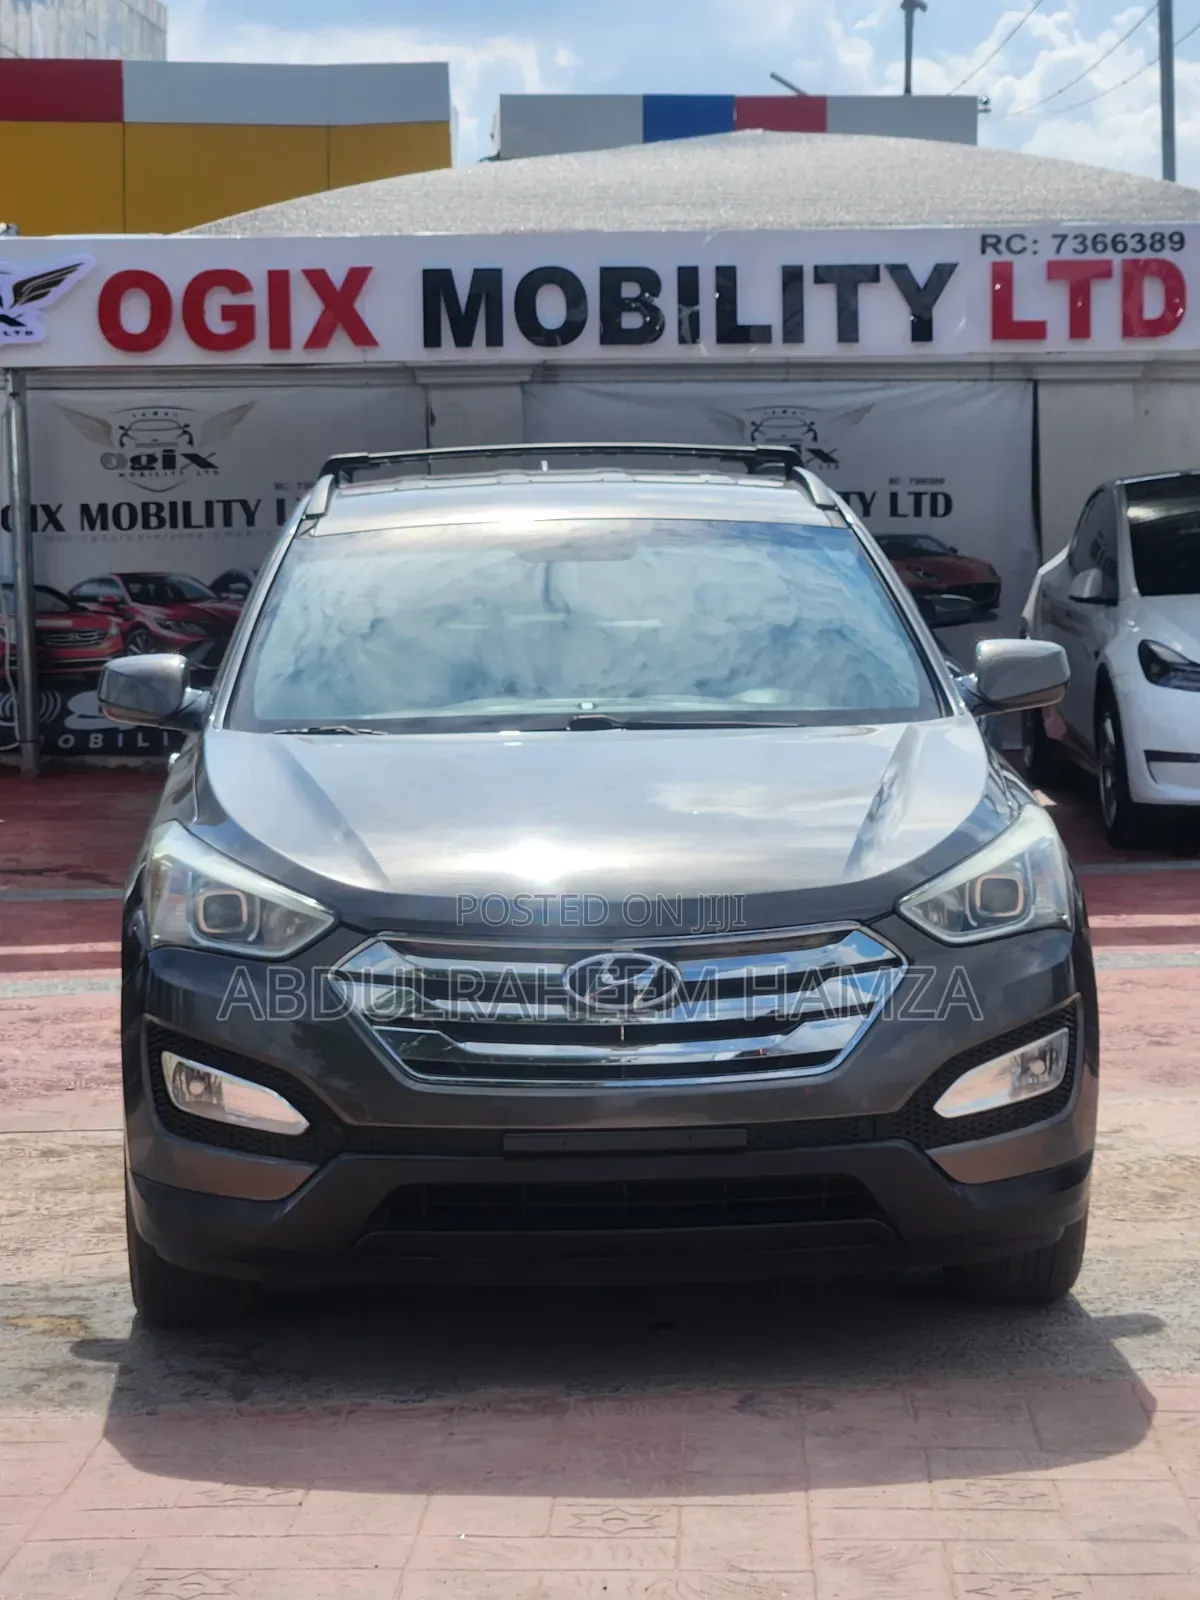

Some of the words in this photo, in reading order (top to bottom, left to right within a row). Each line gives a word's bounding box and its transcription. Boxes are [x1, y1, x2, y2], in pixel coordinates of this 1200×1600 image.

[980, 233, 1039, 256] RC:
[1051, 231, 1186, 255] 7366389
[97, 265, 379, 353] OGIX
[421, 262, 959, 349] MOBILITY
[990, 257, 1187, 341] LTD
[3, 329, 34, 337] LTD
[79, 499, 262, 532] MOBILITY
[888, 491, 954, 518] LTD
